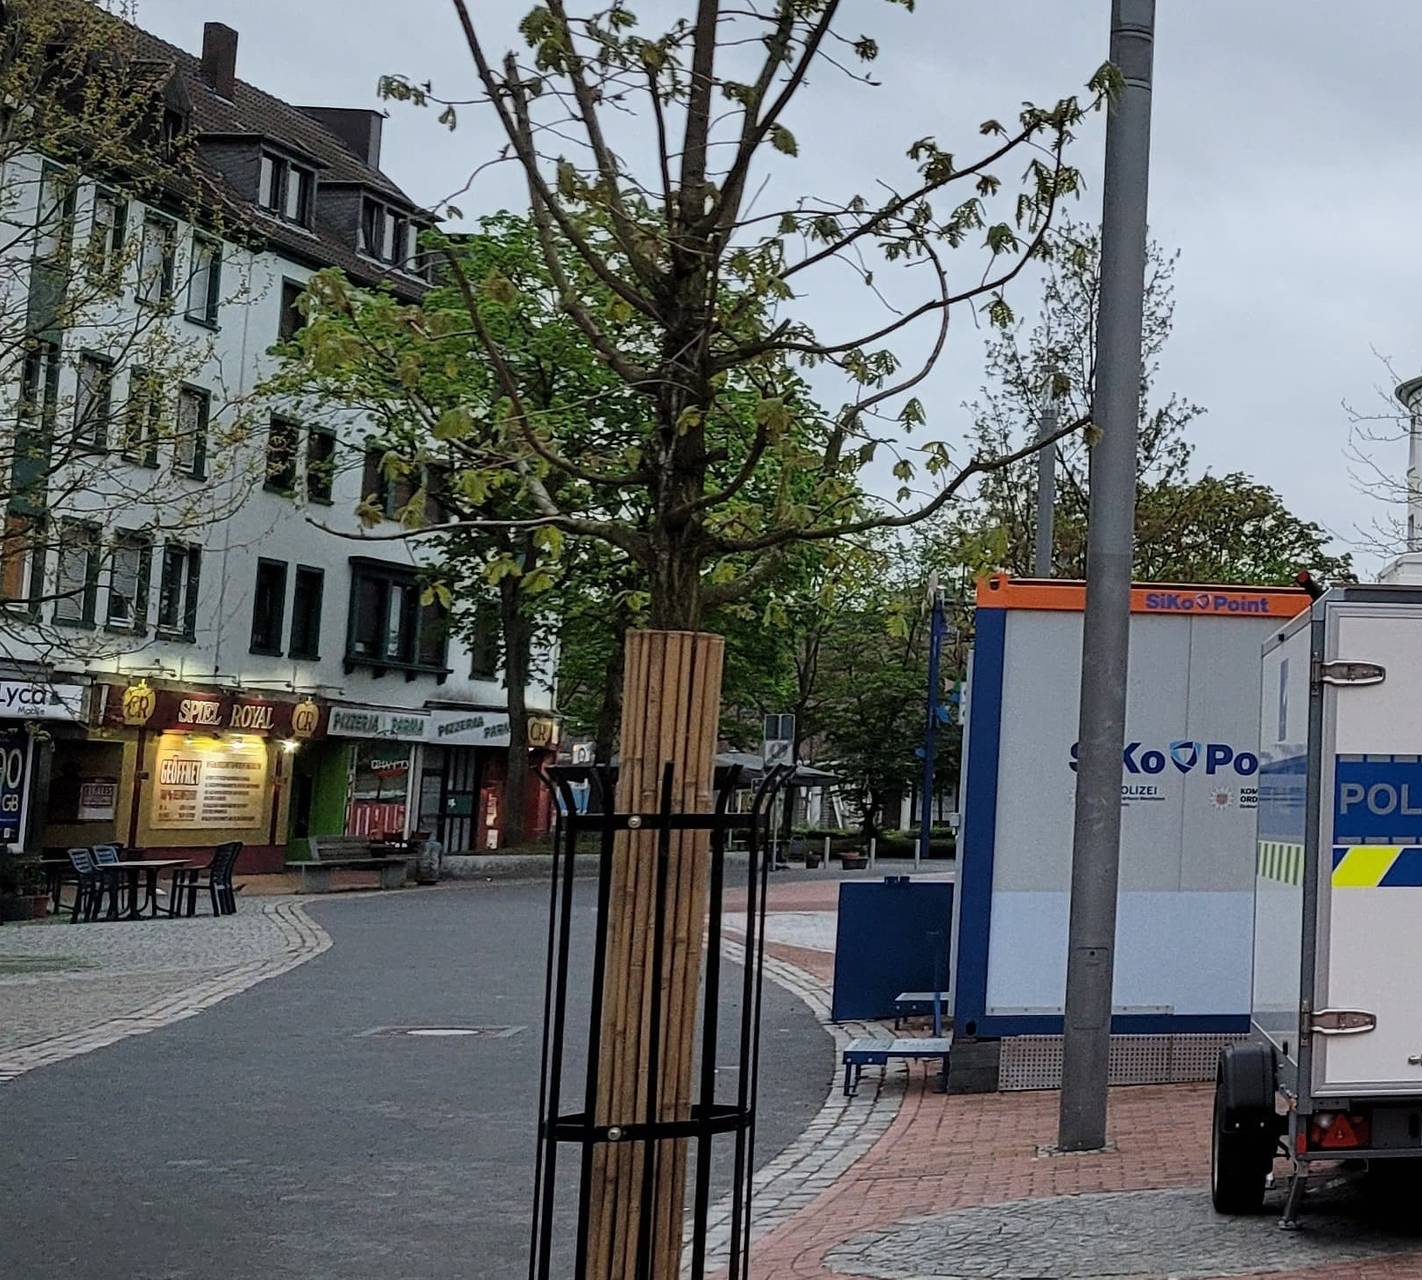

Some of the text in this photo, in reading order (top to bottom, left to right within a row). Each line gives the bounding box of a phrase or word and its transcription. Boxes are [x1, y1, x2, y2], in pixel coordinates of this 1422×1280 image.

[1146, 592, 1270, 612] SiKo Point
[178, 699, 275, 729] SPIEL ROYAL
[161, 755, 201, 785] GEÖFFNET
[1121, 785, 1157, 795] OLIZEI
[2, 794, 19, 811] GB
